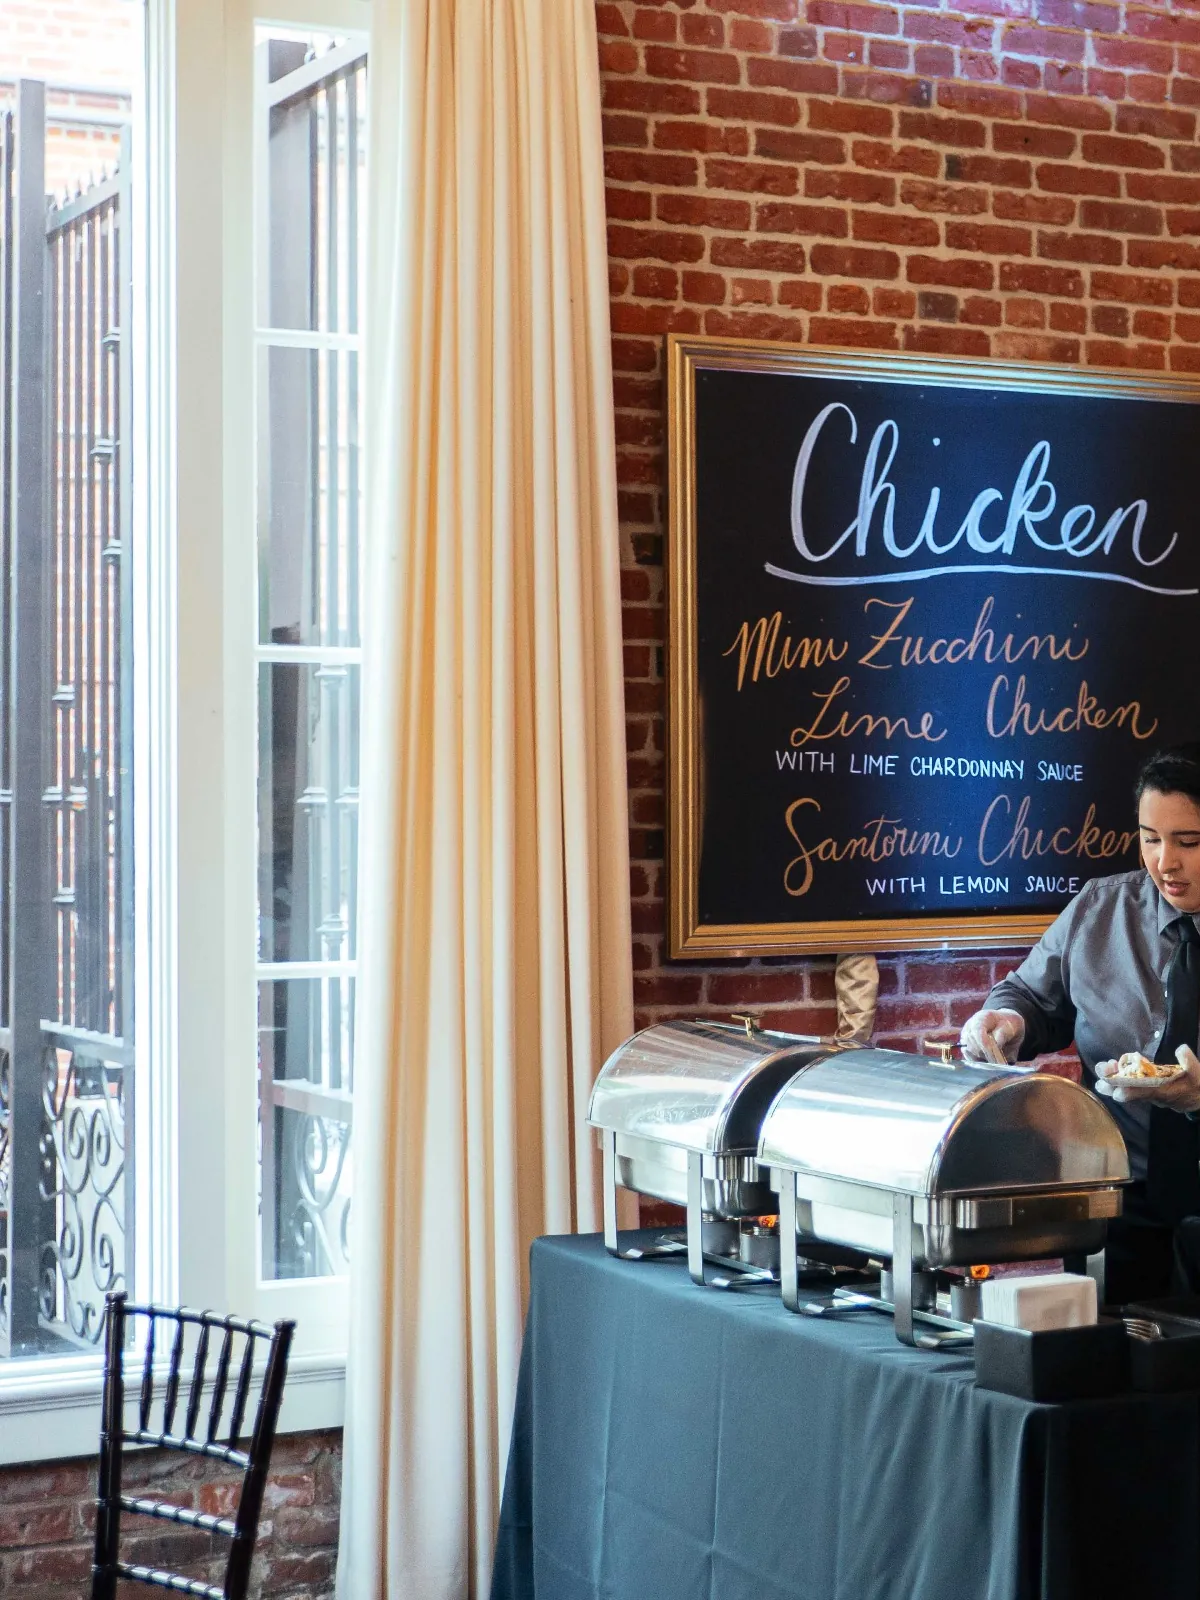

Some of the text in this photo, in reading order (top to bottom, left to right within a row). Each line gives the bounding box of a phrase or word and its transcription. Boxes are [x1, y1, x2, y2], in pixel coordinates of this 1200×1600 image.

[791, 402, 1178, 566] Chicken
[722, 596, 1091, 692] Mini Zucchini
[790, 674, 1158, 747] Lime Chicken
[775, 750, 1084, 782] WITH LIME CHARDONNAY SAUCE
[783, 797, 963, 896] Santorini
[865, 875, 1080, 896] WITH LEMON SAUCE
